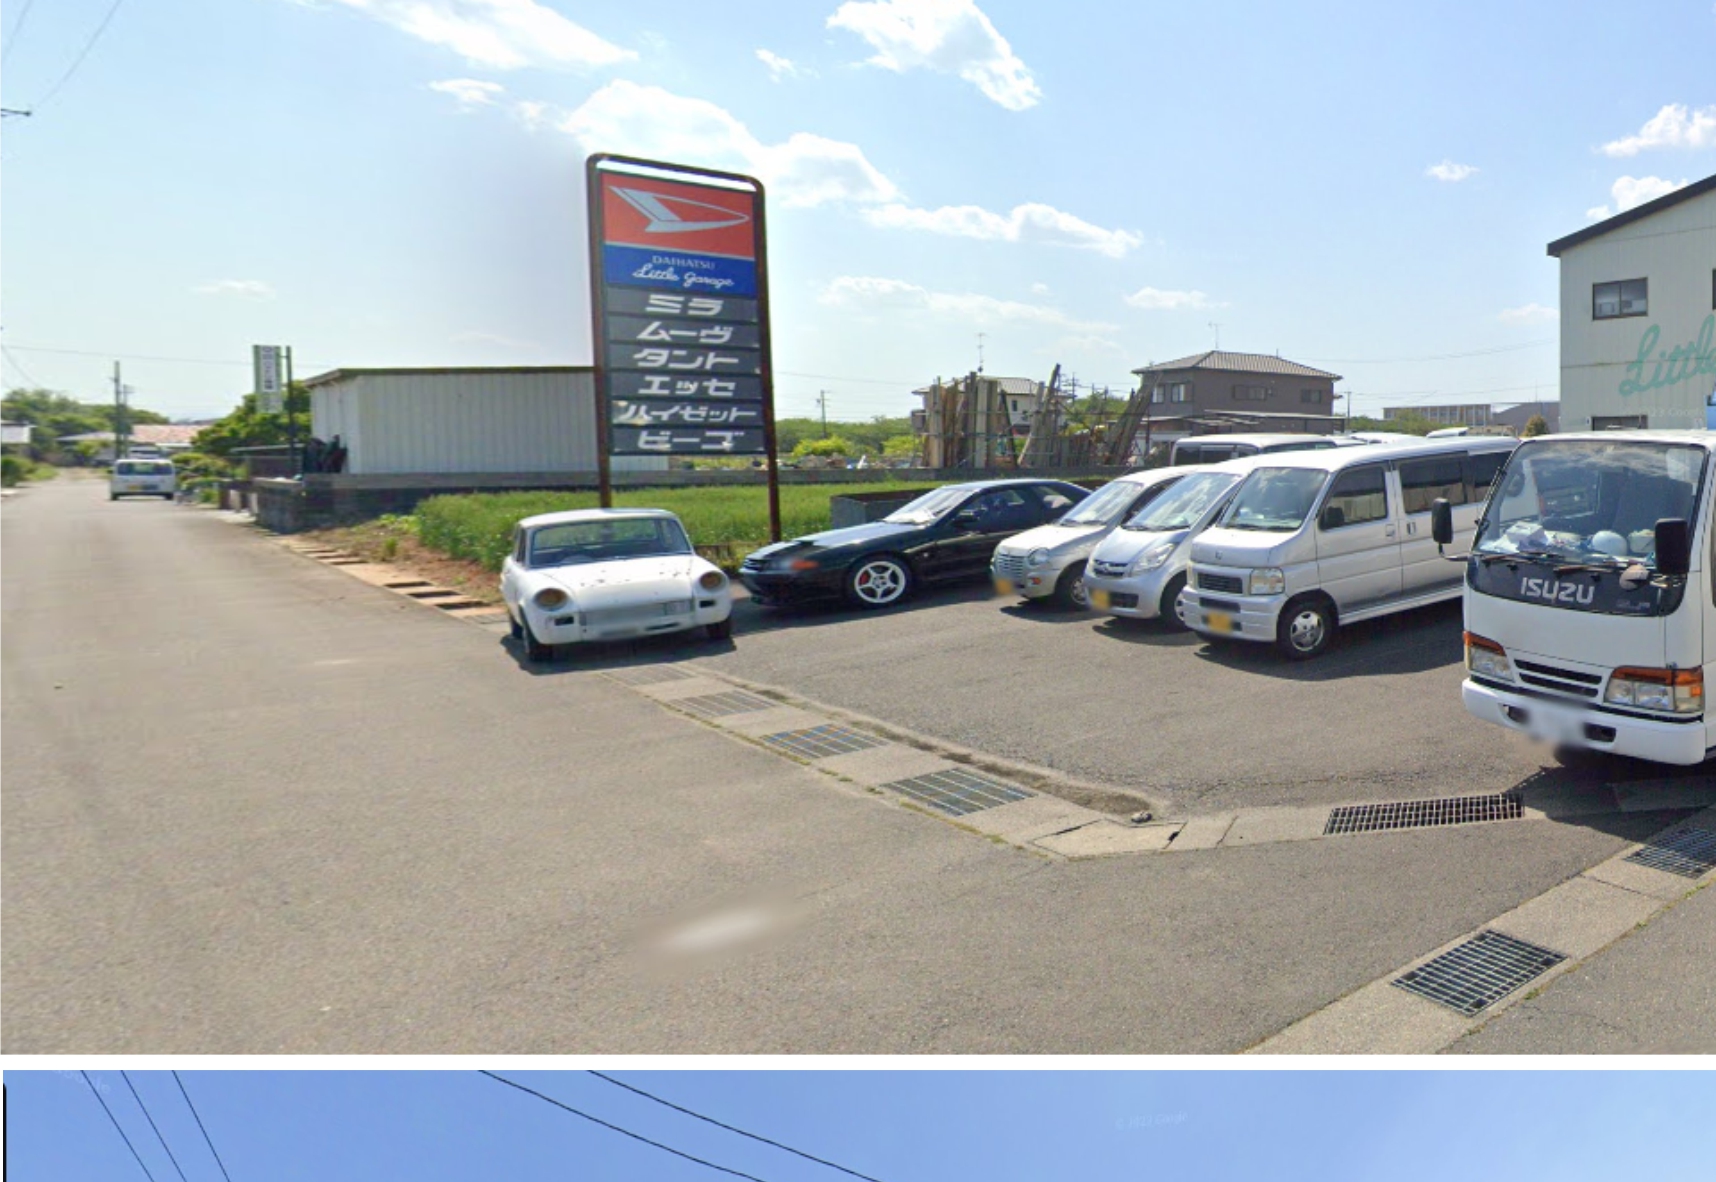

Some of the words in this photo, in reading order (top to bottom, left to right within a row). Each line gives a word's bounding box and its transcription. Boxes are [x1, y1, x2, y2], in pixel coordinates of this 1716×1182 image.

[632, 263, 680, 282] Little
[651, 255, 716, 270] DAIHATSU
[645, 293, 724, 316] ミラ
[636, 321, 733, 344] ムーヴ
[632, 347, 739, 371] タント
[637, 374, 736, 398] エッセ
[617, 403, 757, 423] ハイゼット
[637, 430, 745, 452] ビーゴ
[1520, 577, 1595, 605] ISUZU
